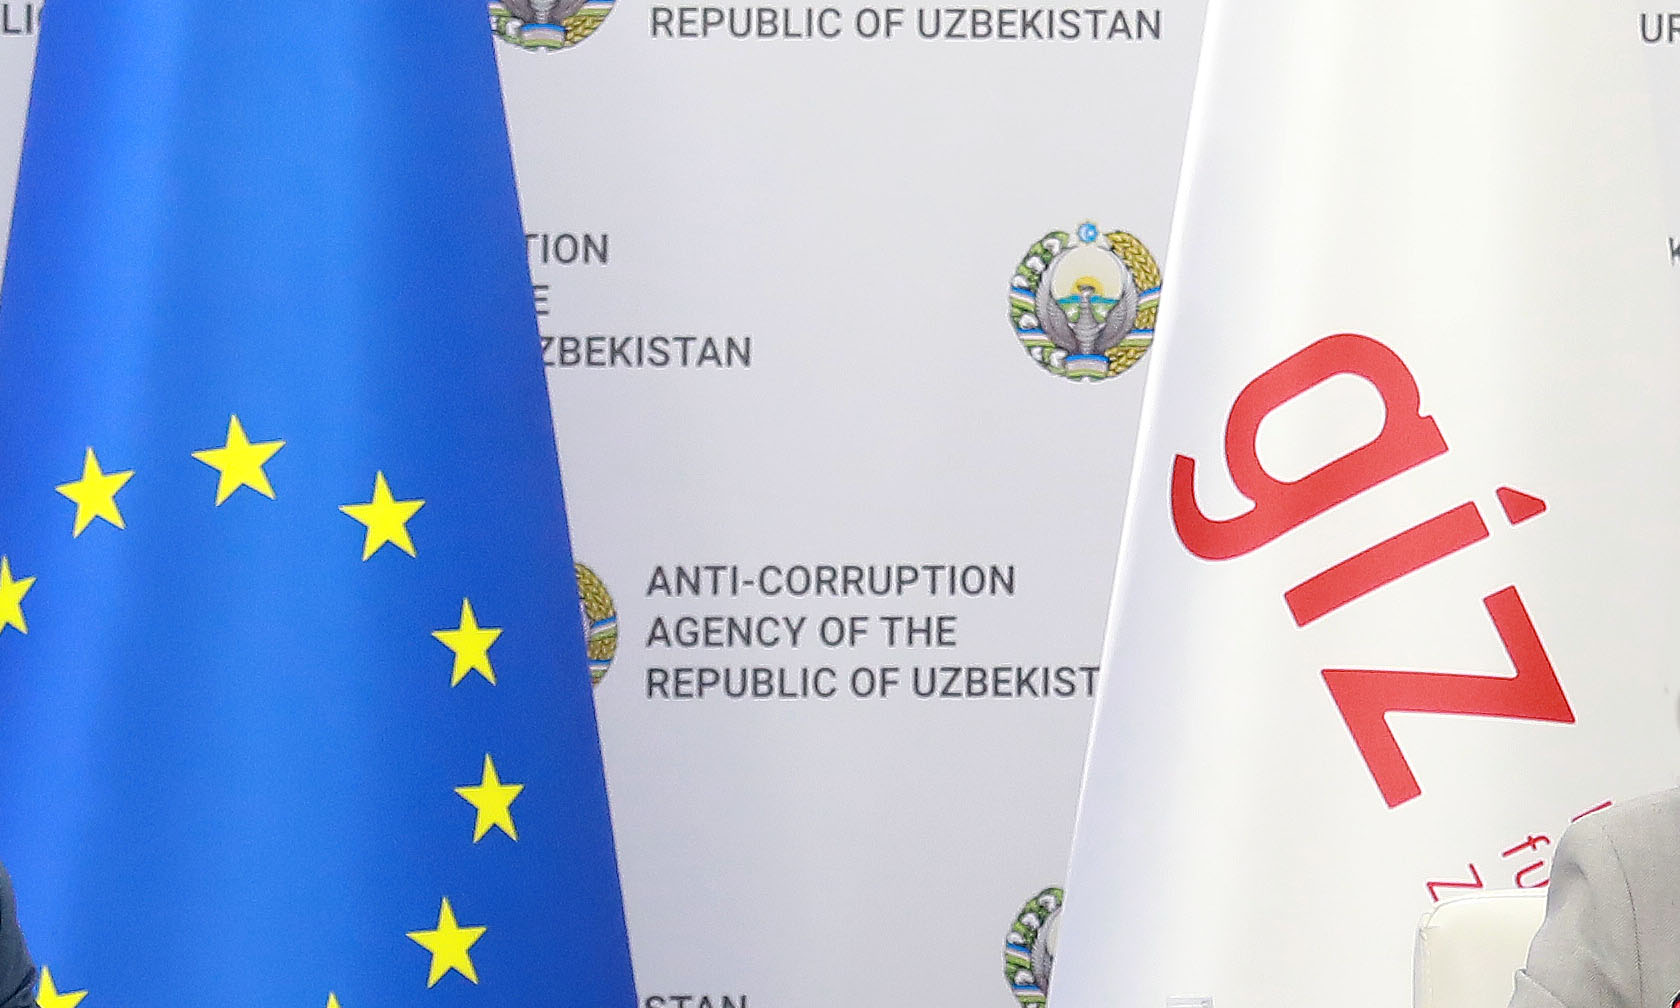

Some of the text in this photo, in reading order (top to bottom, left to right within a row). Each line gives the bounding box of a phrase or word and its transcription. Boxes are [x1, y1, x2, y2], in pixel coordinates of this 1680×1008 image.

[650, 6, 1161, 41] REPUBLIC OF UZBEKISTAN
[645, 563, 1016, 598] ANTI-CORRUPTION
[644, 614, 958, 649] AGENCY OF THE
[645, 666, 837, 700] REPUBLIC
[849, 666, 901, 698] OF
